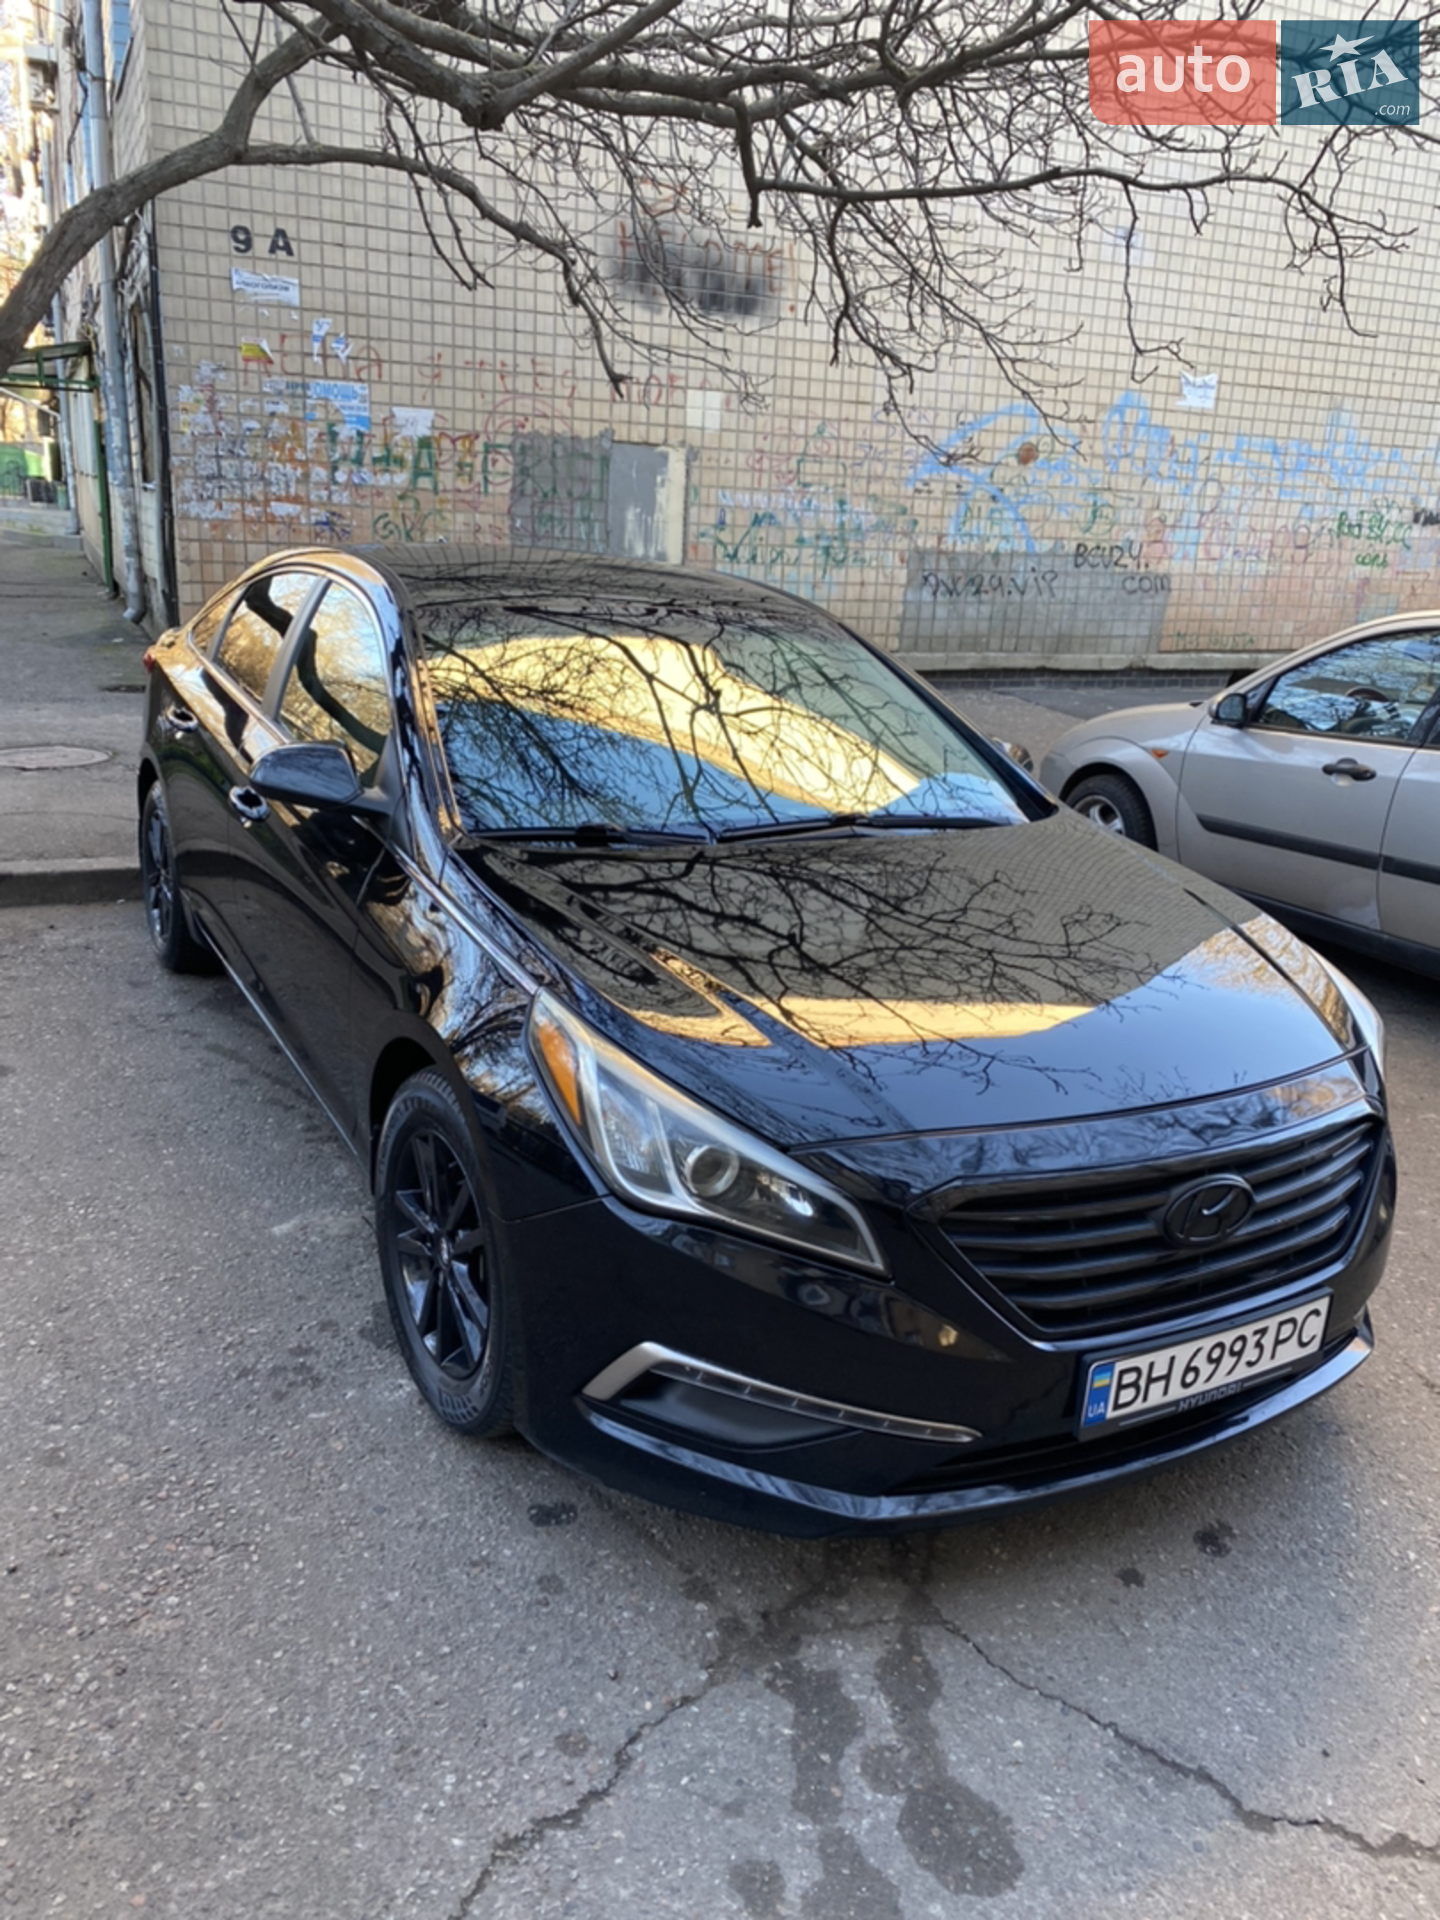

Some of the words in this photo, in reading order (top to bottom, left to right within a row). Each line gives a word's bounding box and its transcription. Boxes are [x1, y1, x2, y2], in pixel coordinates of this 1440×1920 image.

[230, 225, 253, 253] 9
[268, 227, 294, 256] А
[311, 381, 358, 402] ОМОЩЬ
[1088, 1402, 1105, 1417] UA
[1177, 1381, 1242, 1412] HYUNDAI
